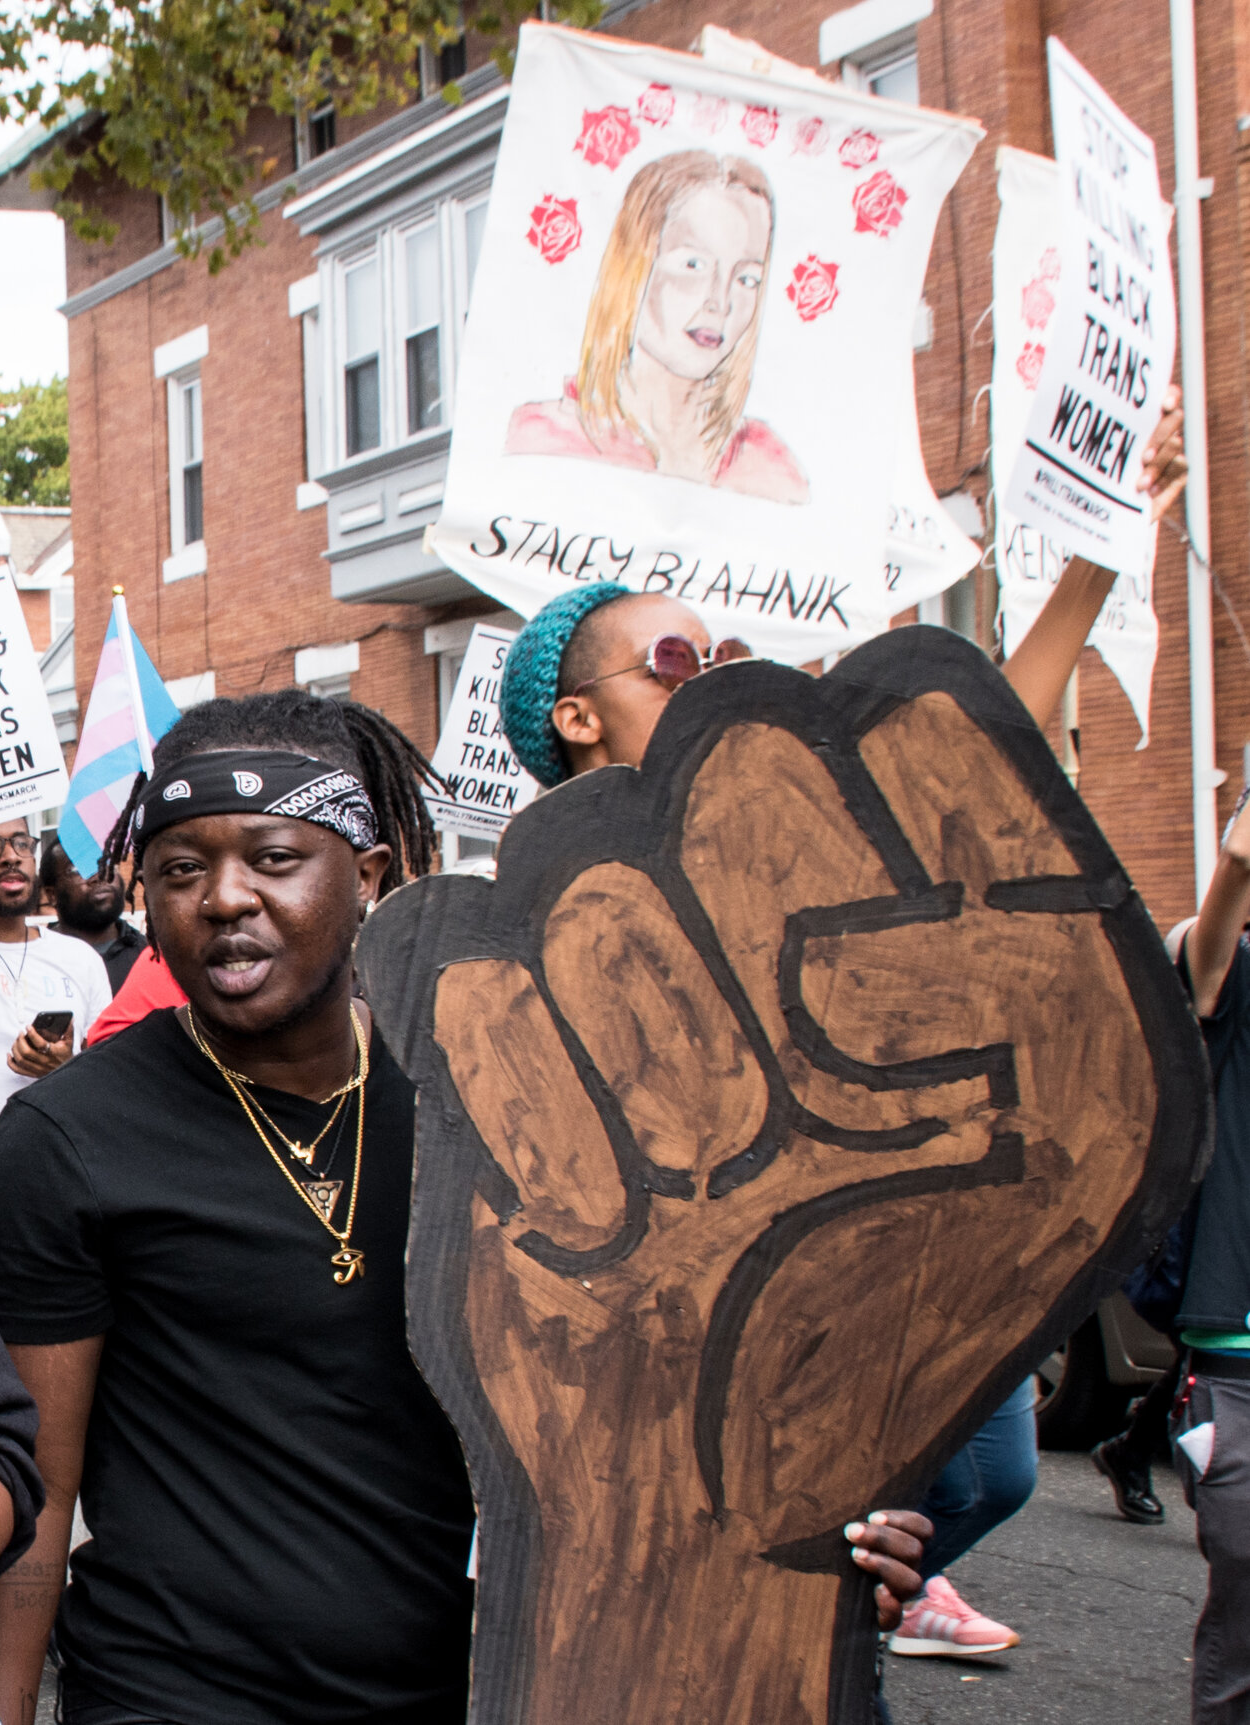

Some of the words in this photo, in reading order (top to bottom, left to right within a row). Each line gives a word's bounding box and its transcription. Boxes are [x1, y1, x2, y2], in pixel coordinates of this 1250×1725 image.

[1081, 106, 1129, 190] STOP
[1072, 160, 1154, 272] KILLING
[1087, 237, 1153, 340] BLACK
[1078, 313, 1151, 409] TRANS
[1049, 384, 1137, 485] WOMEN
[470, 515, 635, 582] STACEY
[643, 551, 852, 630] BLAHNIK
[459, 742, 521, 777] TRANS
[467, 710, 503, 740] BLA
[446, 773, 519, 811] WOMEN
